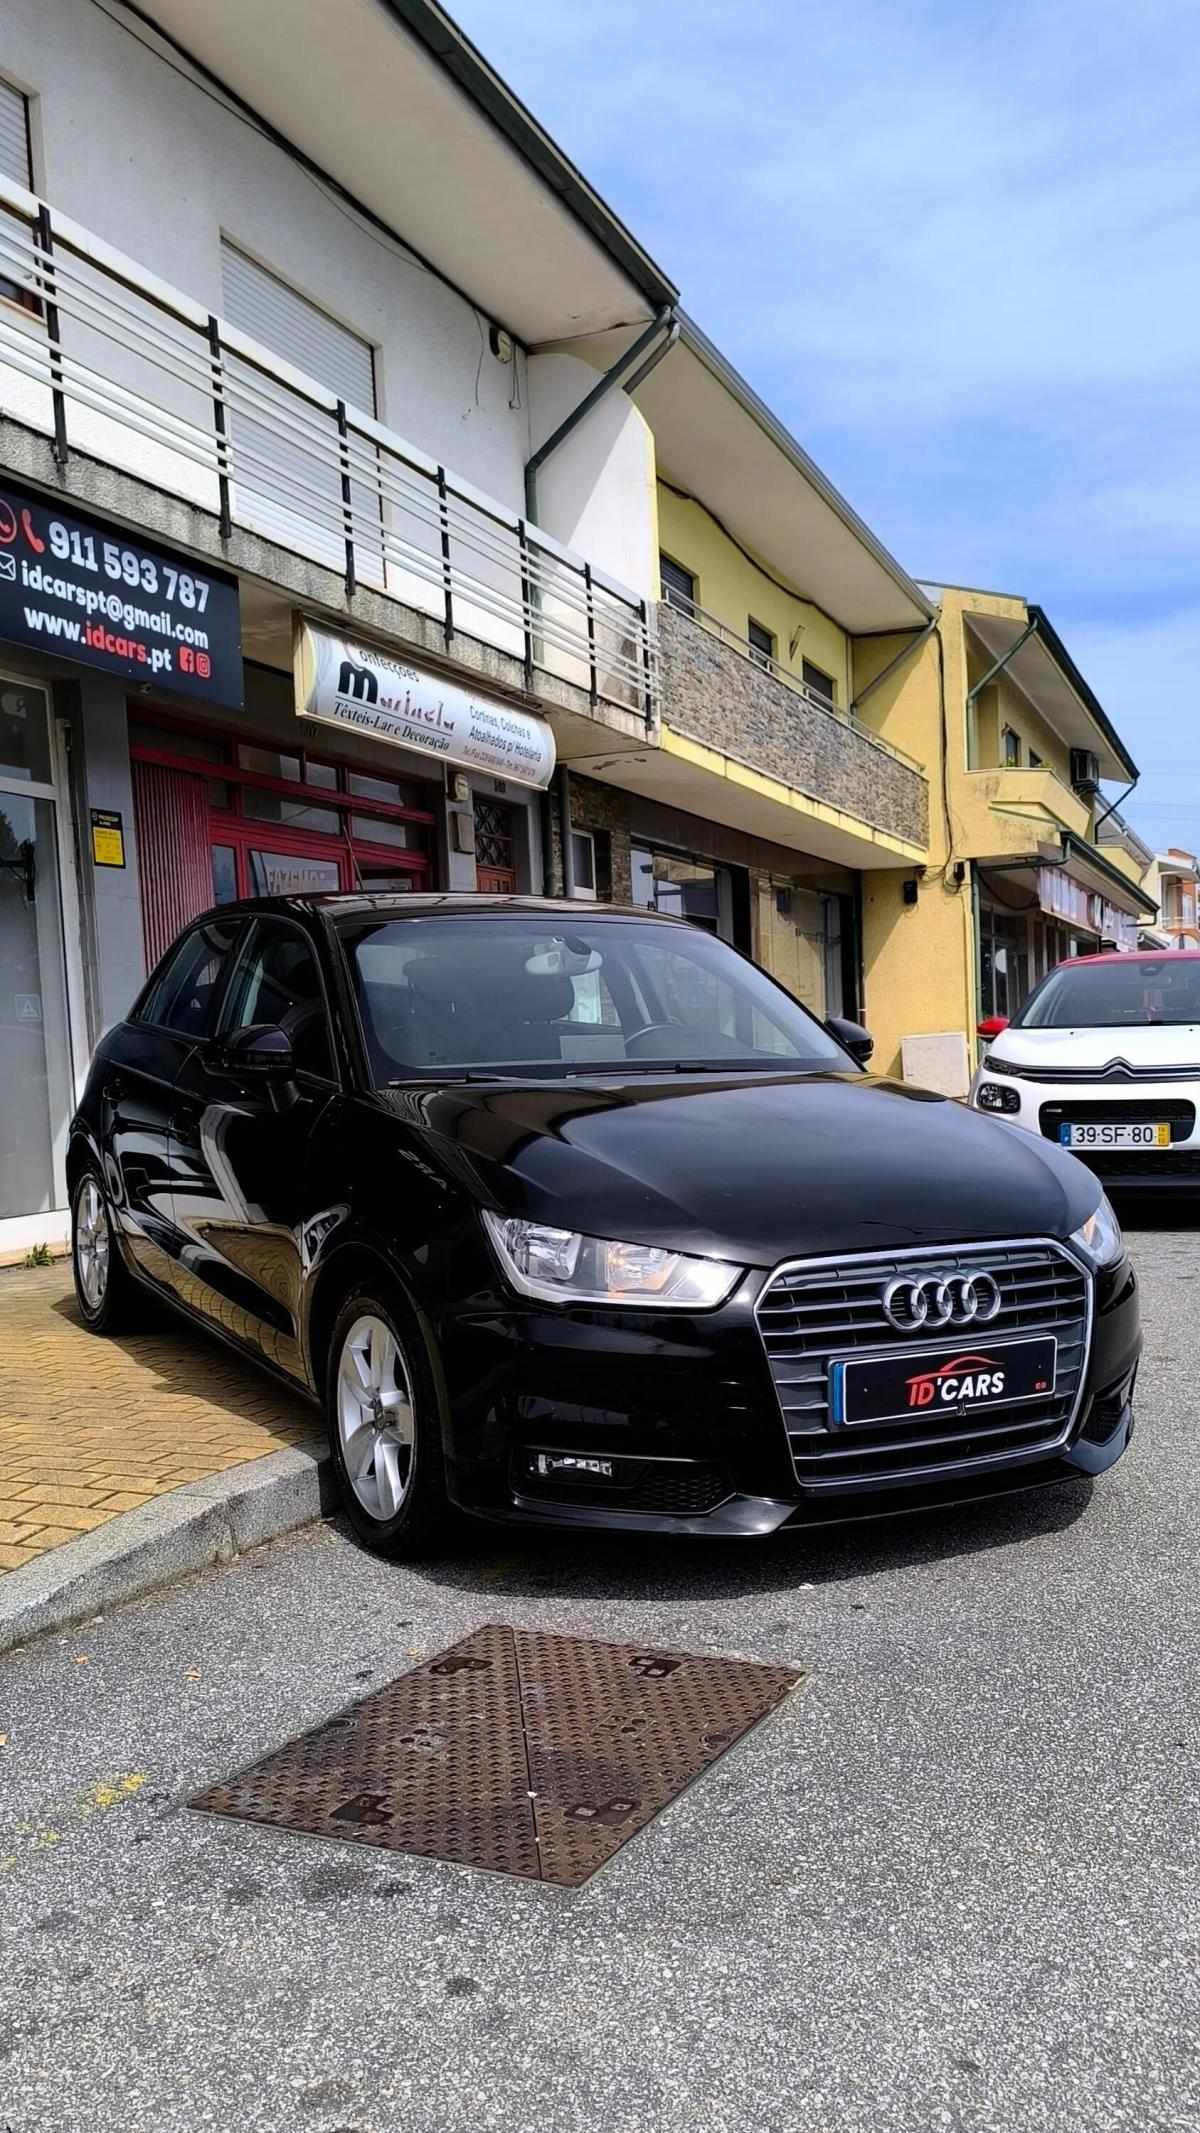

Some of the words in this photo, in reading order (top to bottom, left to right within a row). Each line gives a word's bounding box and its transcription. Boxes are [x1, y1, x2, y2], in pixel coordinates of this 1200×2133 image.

[49, 521, 98, 572] 911
[103, 542, 158, 594] 593
[163, 566, 209, 613] 787
[21, 560, 209, 649] idcarspt@gmail.com
[24, 607, 172, 673] www.idcars.pt
[333, 701, 394, 732] Têxteis-Lar
[402, 725, 451, 751] Decoração
[909, 1371, 1005, 1407] ID'CARS
